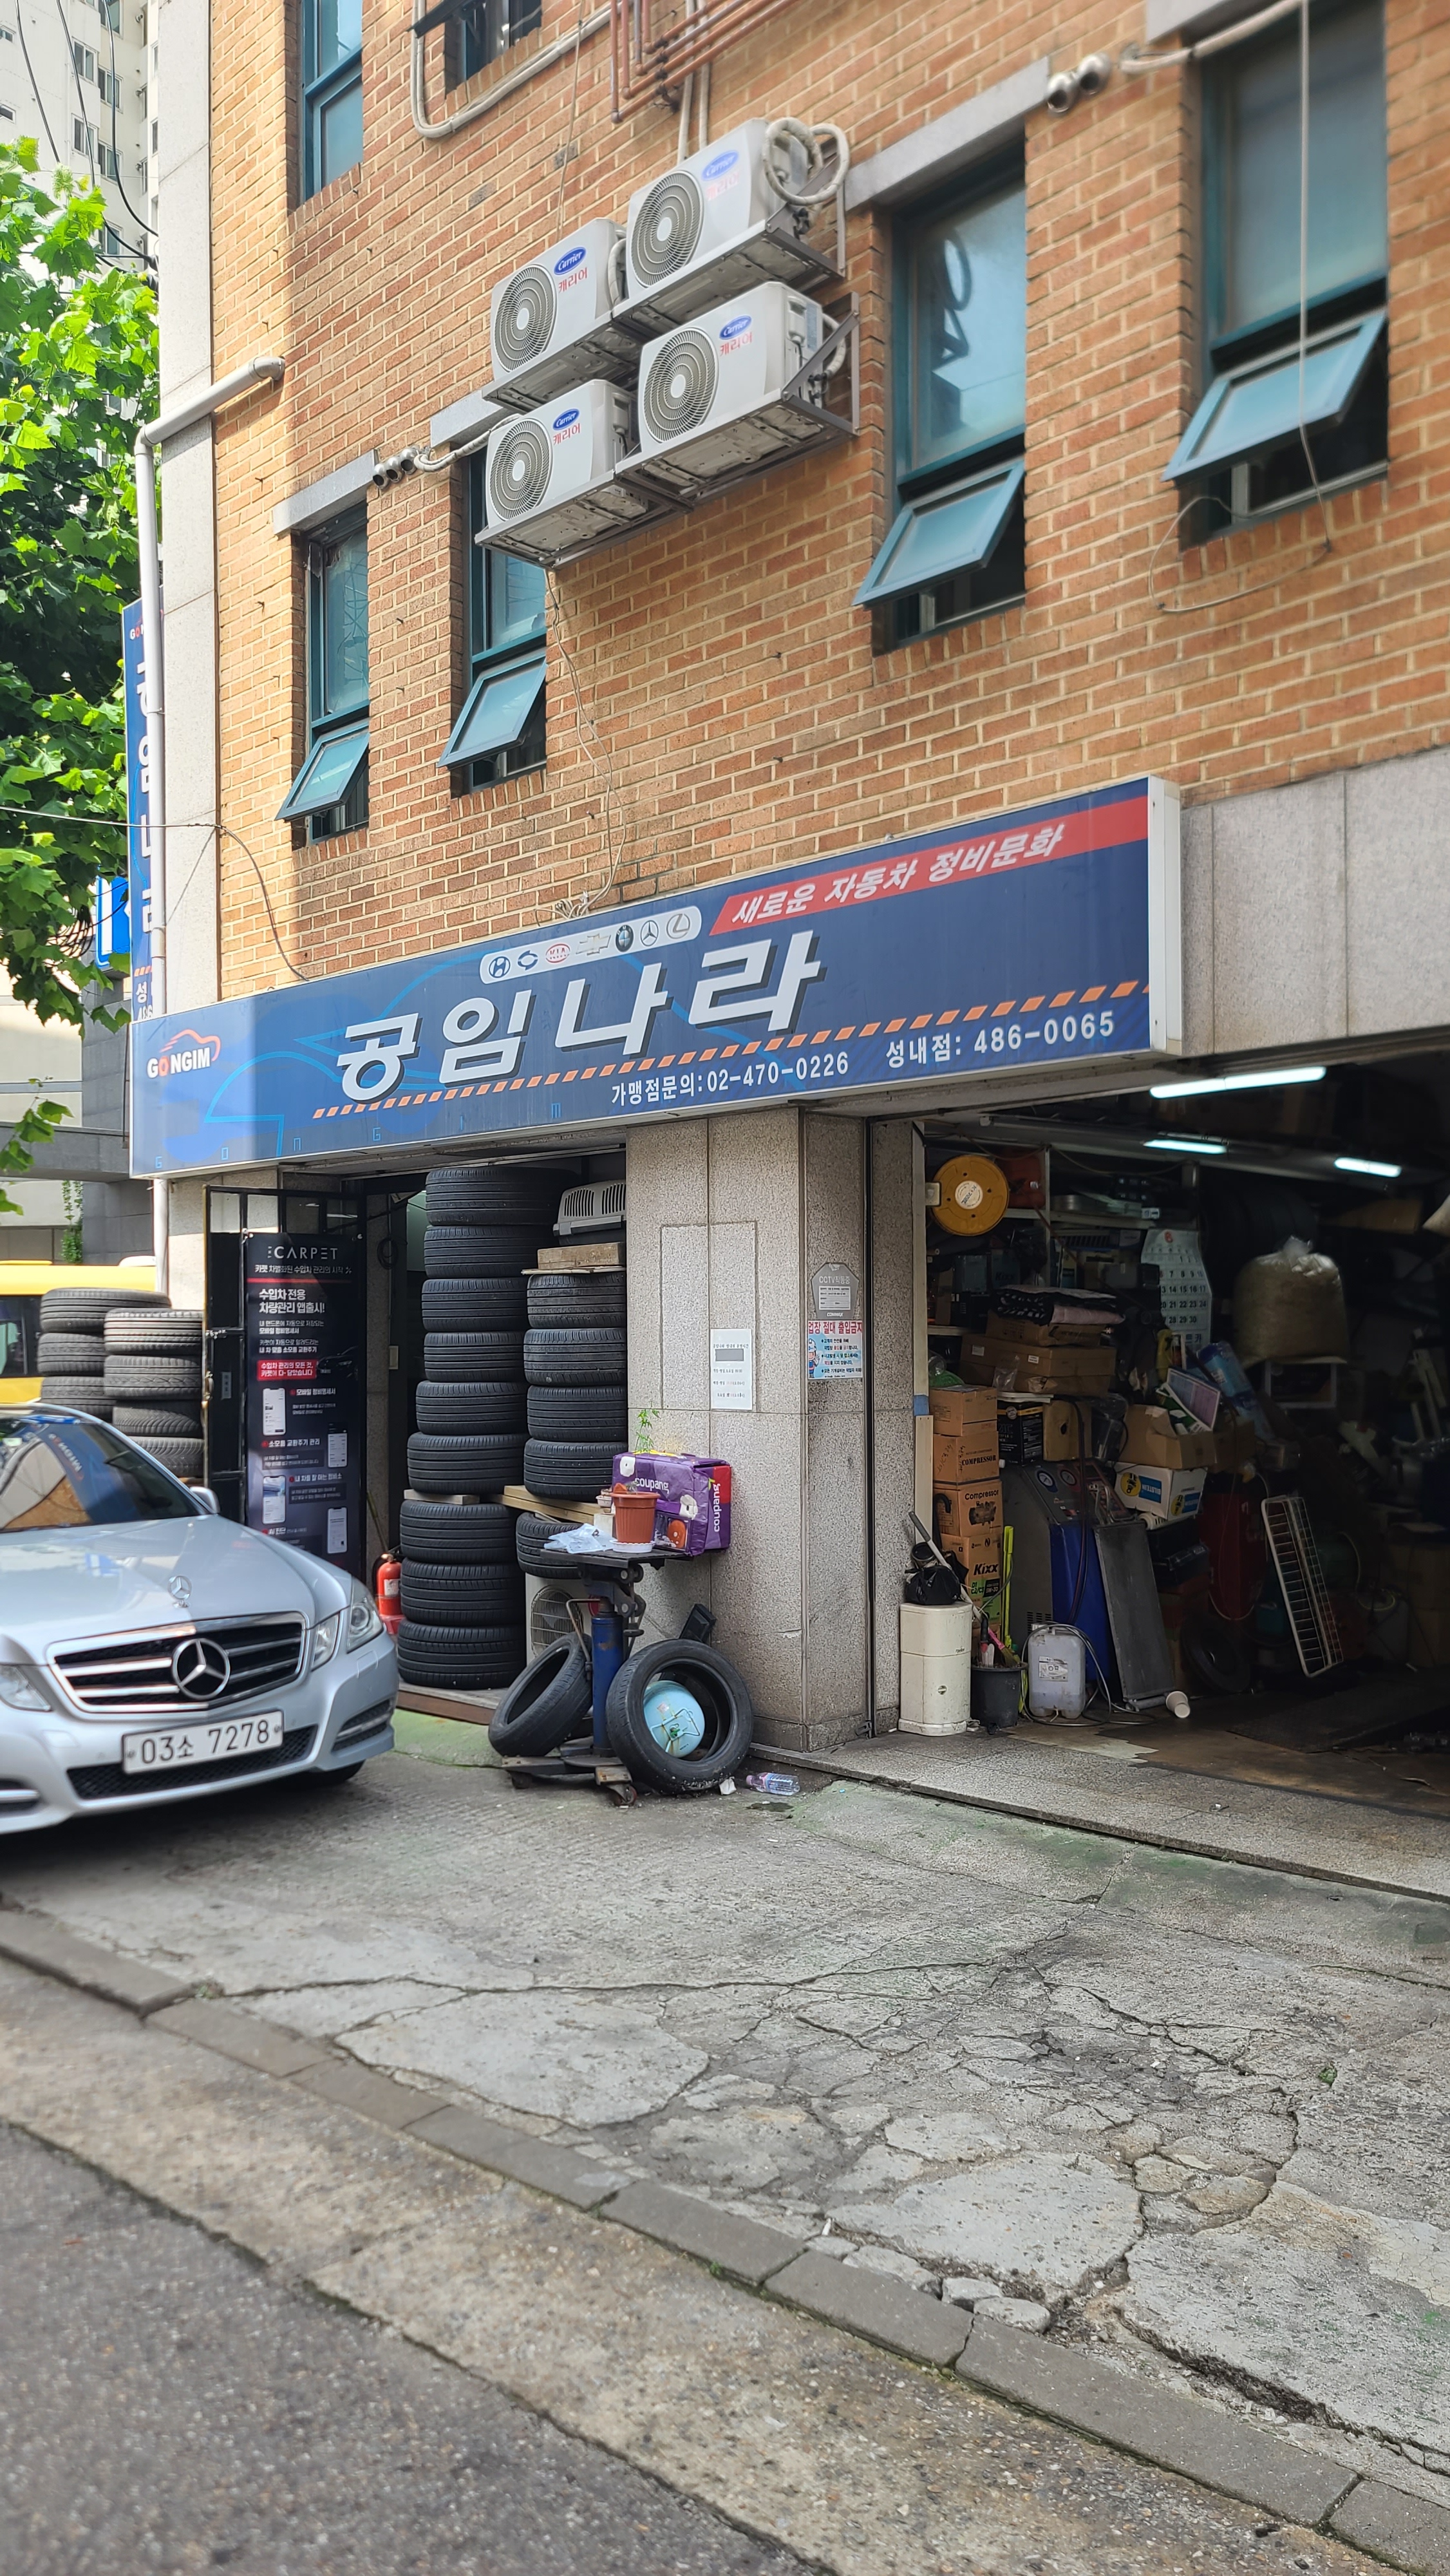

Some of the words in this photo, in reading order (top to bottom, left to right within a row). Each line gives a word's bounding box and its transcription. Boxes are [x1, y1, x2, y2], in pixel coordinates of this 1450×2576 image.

[558, 251, 583, 272] Carrier
[558, 267, 588, 294] 캐리어
[723, 319, 748, 337] Carrier
[719, 332, 753, 357] 캐리어
[556, 412, 577, 427] Carrier
[553, 423, 580, 446] 캐리어
[732, 883, 816, 923] 새로운
[824, 860, 919, 903] 자동차
[929, 823, 1066, 882] 정비문화
[337, 930, 824, 1106] 공임나라
[886, 1036, 961, 1069] 성내점:
[974, 1010, 1115, 1056] 486-0065
[147, 1046, 211, 1079] GONGIM
[274, 1245, 338, 1260] CARPET
[255, 1264, 268, 1273] 카펫
[294, 1265, 312, 1274] 수입차
[818, 1276, 851, 1284] CCTV작동중
[259, 1288, 287, 1300] 수입차
[288, 1289, 306, 1300] 전용
[259, 1302, 296, 1314] 차량관리
[823, 1321, 836, 1334] 절대
[962, 1455, 997, 1466] COMPRESSOR
[634, 1477, 670, 1494] coupang
[965, 1490, 999, 1500] Compressor
[713, 1483, 722, 1533] coupang
[974, 1563, 999, 1575] Kixx
[141, 1736, 195, 1765] 03소
[208, 1720, 270, 1755] 7278
